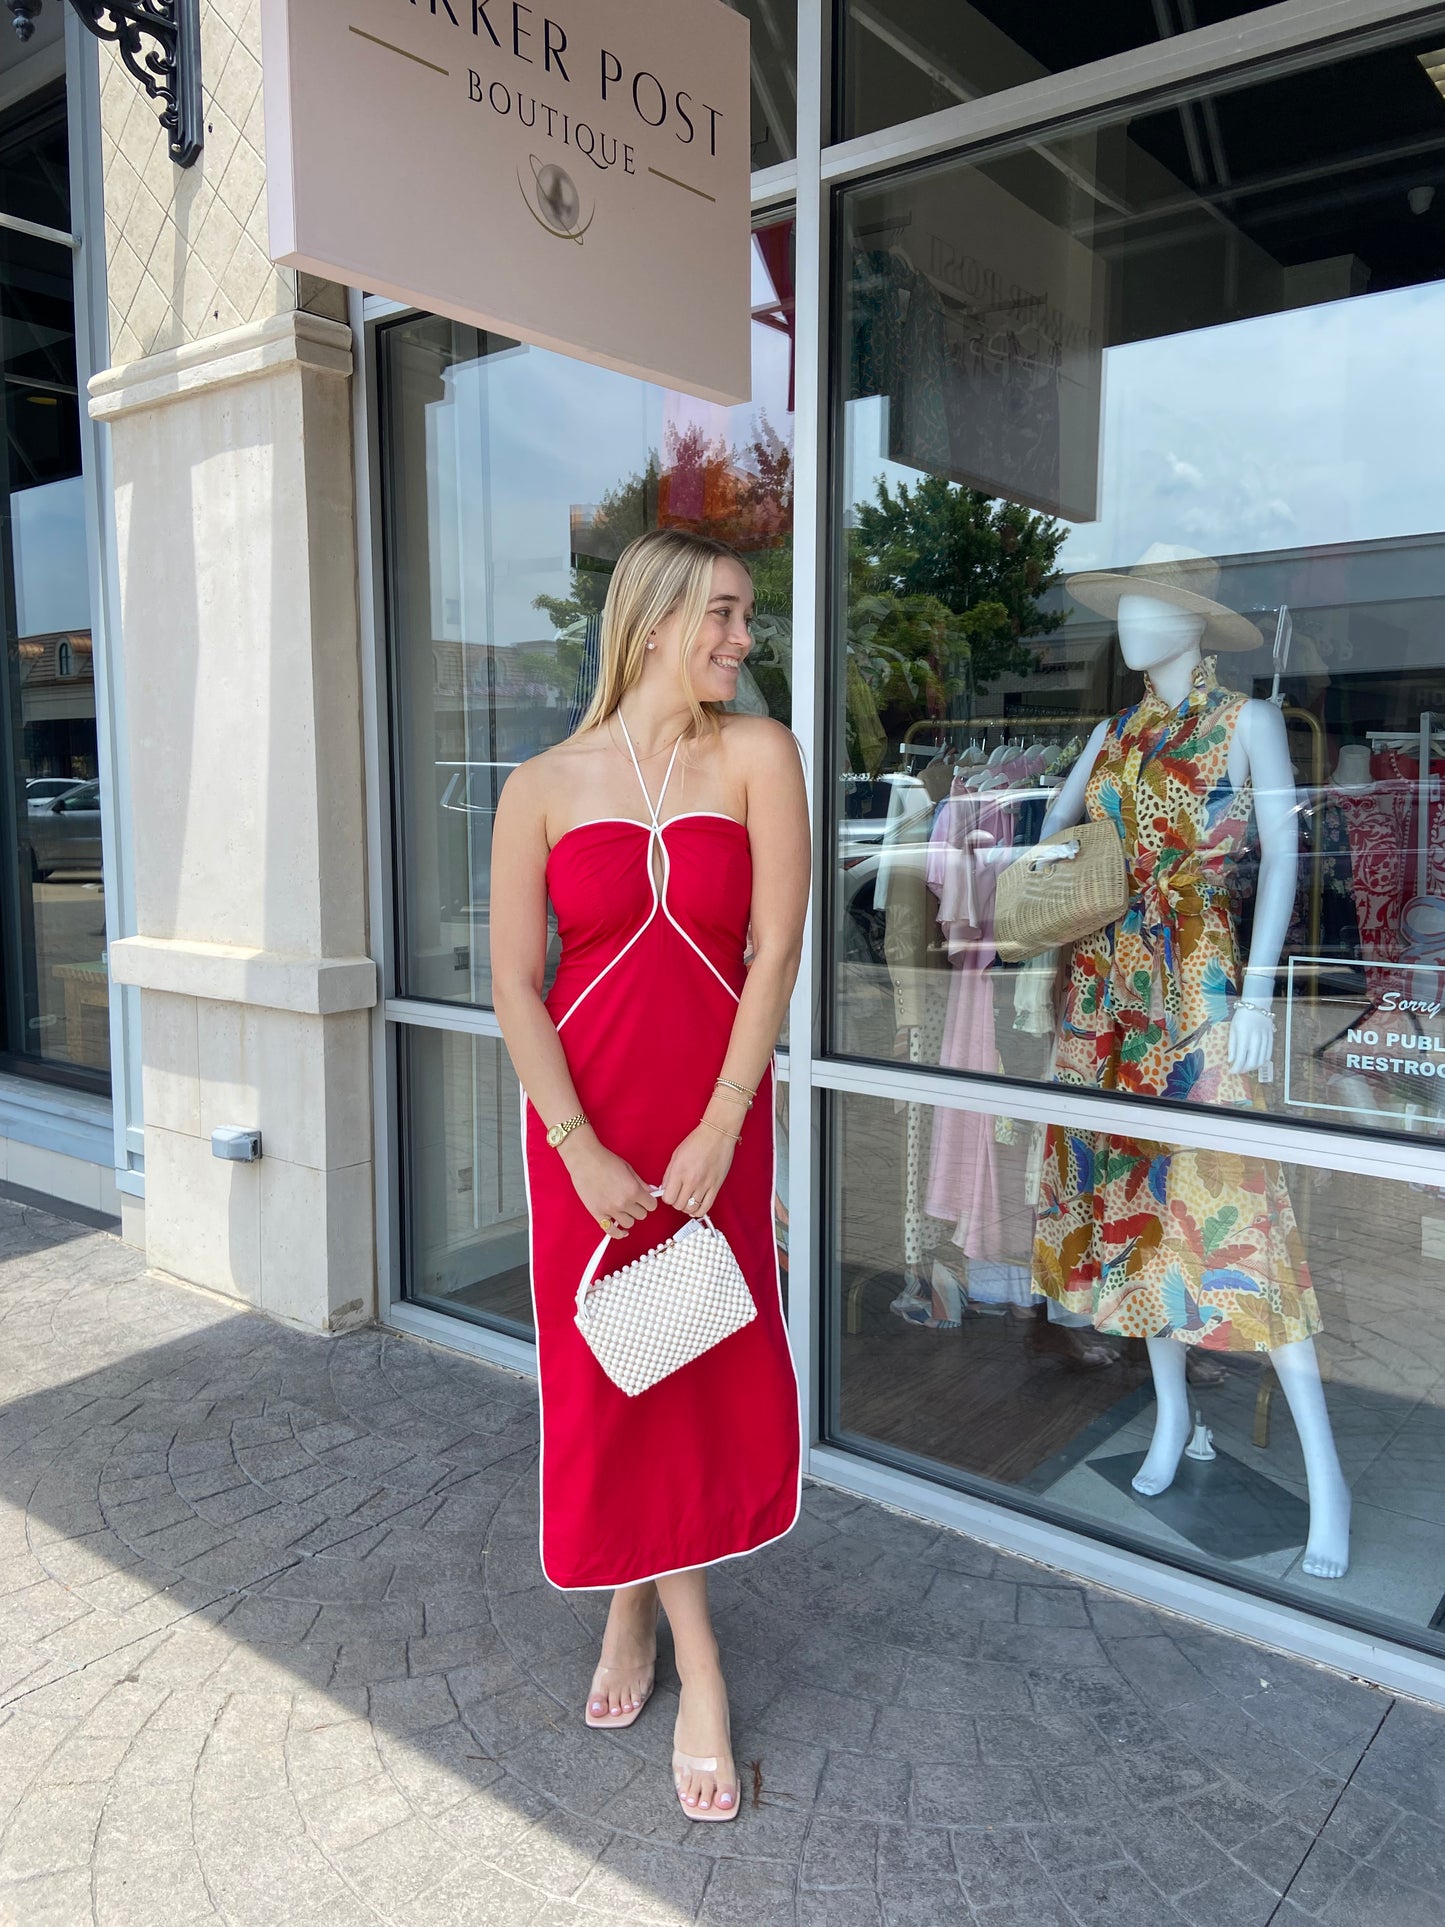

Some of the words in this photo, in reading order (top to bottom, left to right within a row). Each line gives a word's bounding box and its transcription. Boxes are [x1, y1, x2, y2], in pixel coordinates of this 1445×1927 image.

[409, 0, 570, 82] KER
[601, 49, 723, 156] POST
[467, 68, 636, 175] BOUTIQUE
[1378, 992, 1441, 1019] Sorry
[1347, 1029, 1379, 1045] NO
[1386, 1033, 1445, 1051] PUBL
